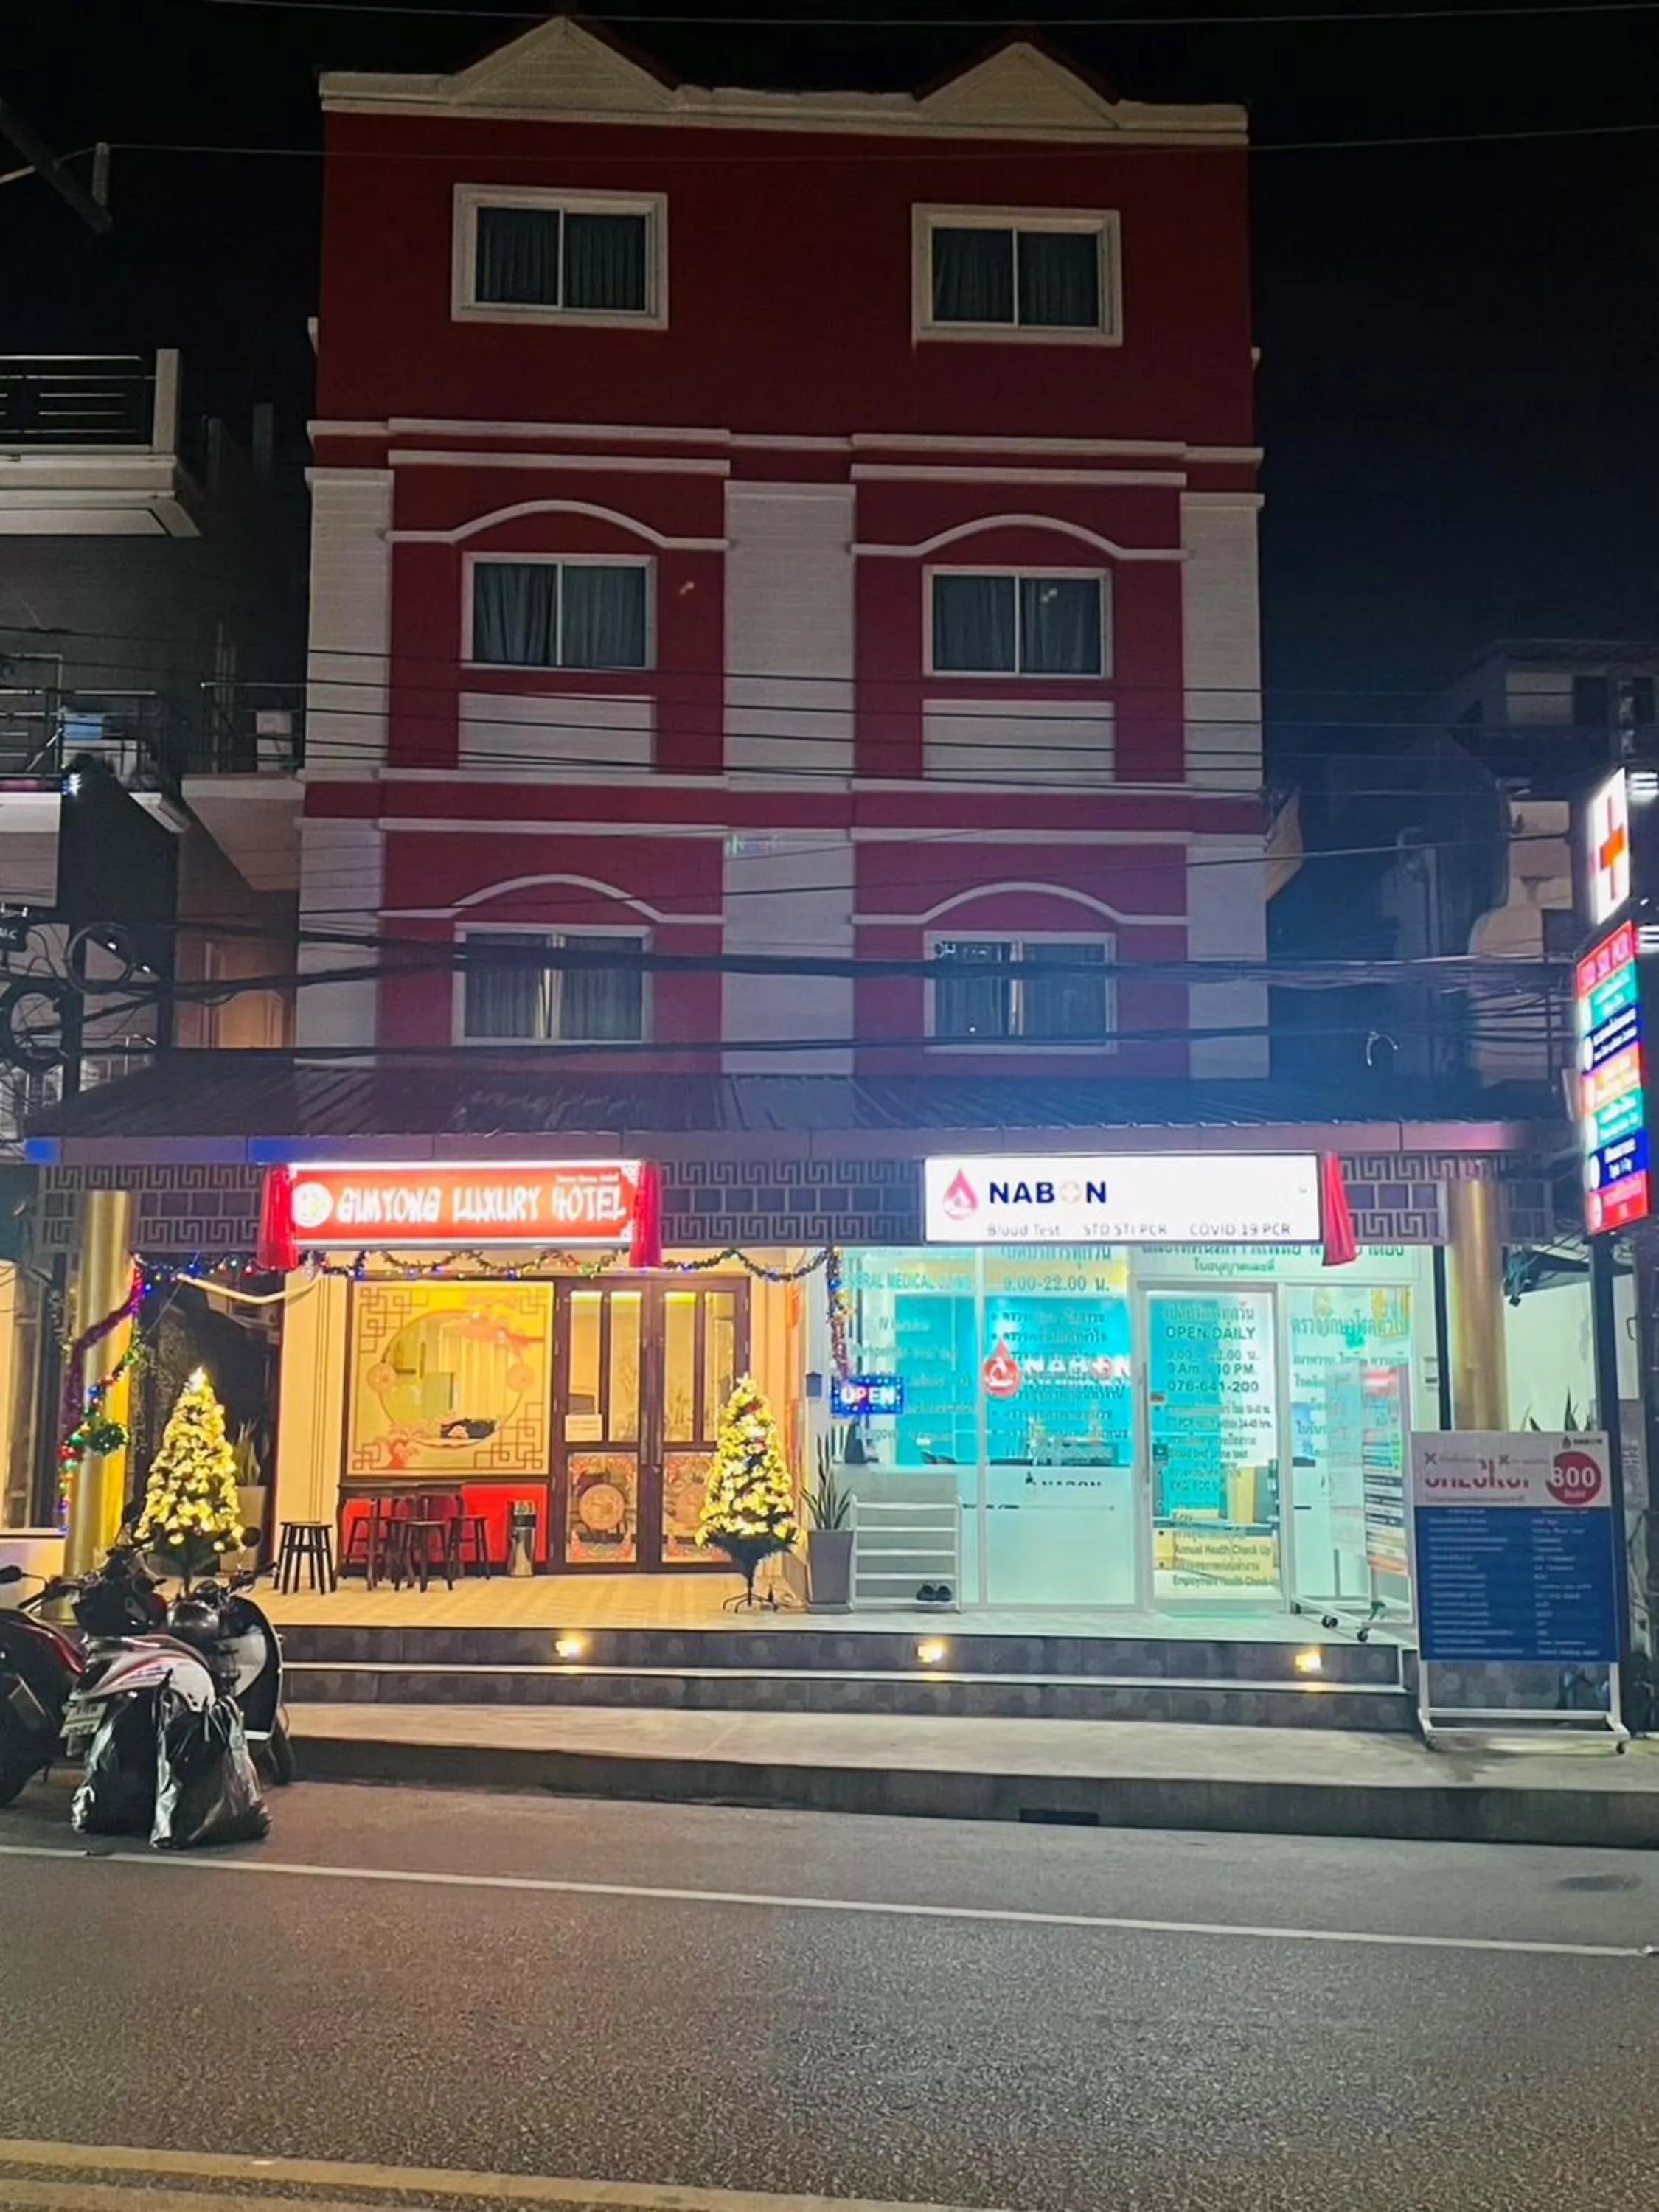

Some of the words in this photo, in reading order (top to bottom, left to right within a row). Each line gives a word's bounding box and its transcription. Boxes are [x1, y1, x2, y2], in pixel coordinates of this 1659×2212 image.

[453, 1186, 542, 1222] LUXURY
[552, 1184, 627, 1221] HOTEL
[987, 1224, 1028, 1237] Blood
[1034, 1224, 1060, 1237] Test
[1084, 1223, 1110, 1236] STD
[1115, 1223, 1135, 1236] STI
[1140, 1223, 1167, 1236] PCR
[1189, 1222, 1237, 1237] COVID
[1242, 1222, 1259, 1236] 19
[1262, 1222, 1291, 1236] PCR
[1166, 1325, 1207, 1340] OPEN
[1211, 1326, 1256, 1340] DAILY
[840, 1385, 896, 1406] OPEN
[1552, 1466, 1595, 1488] 300
